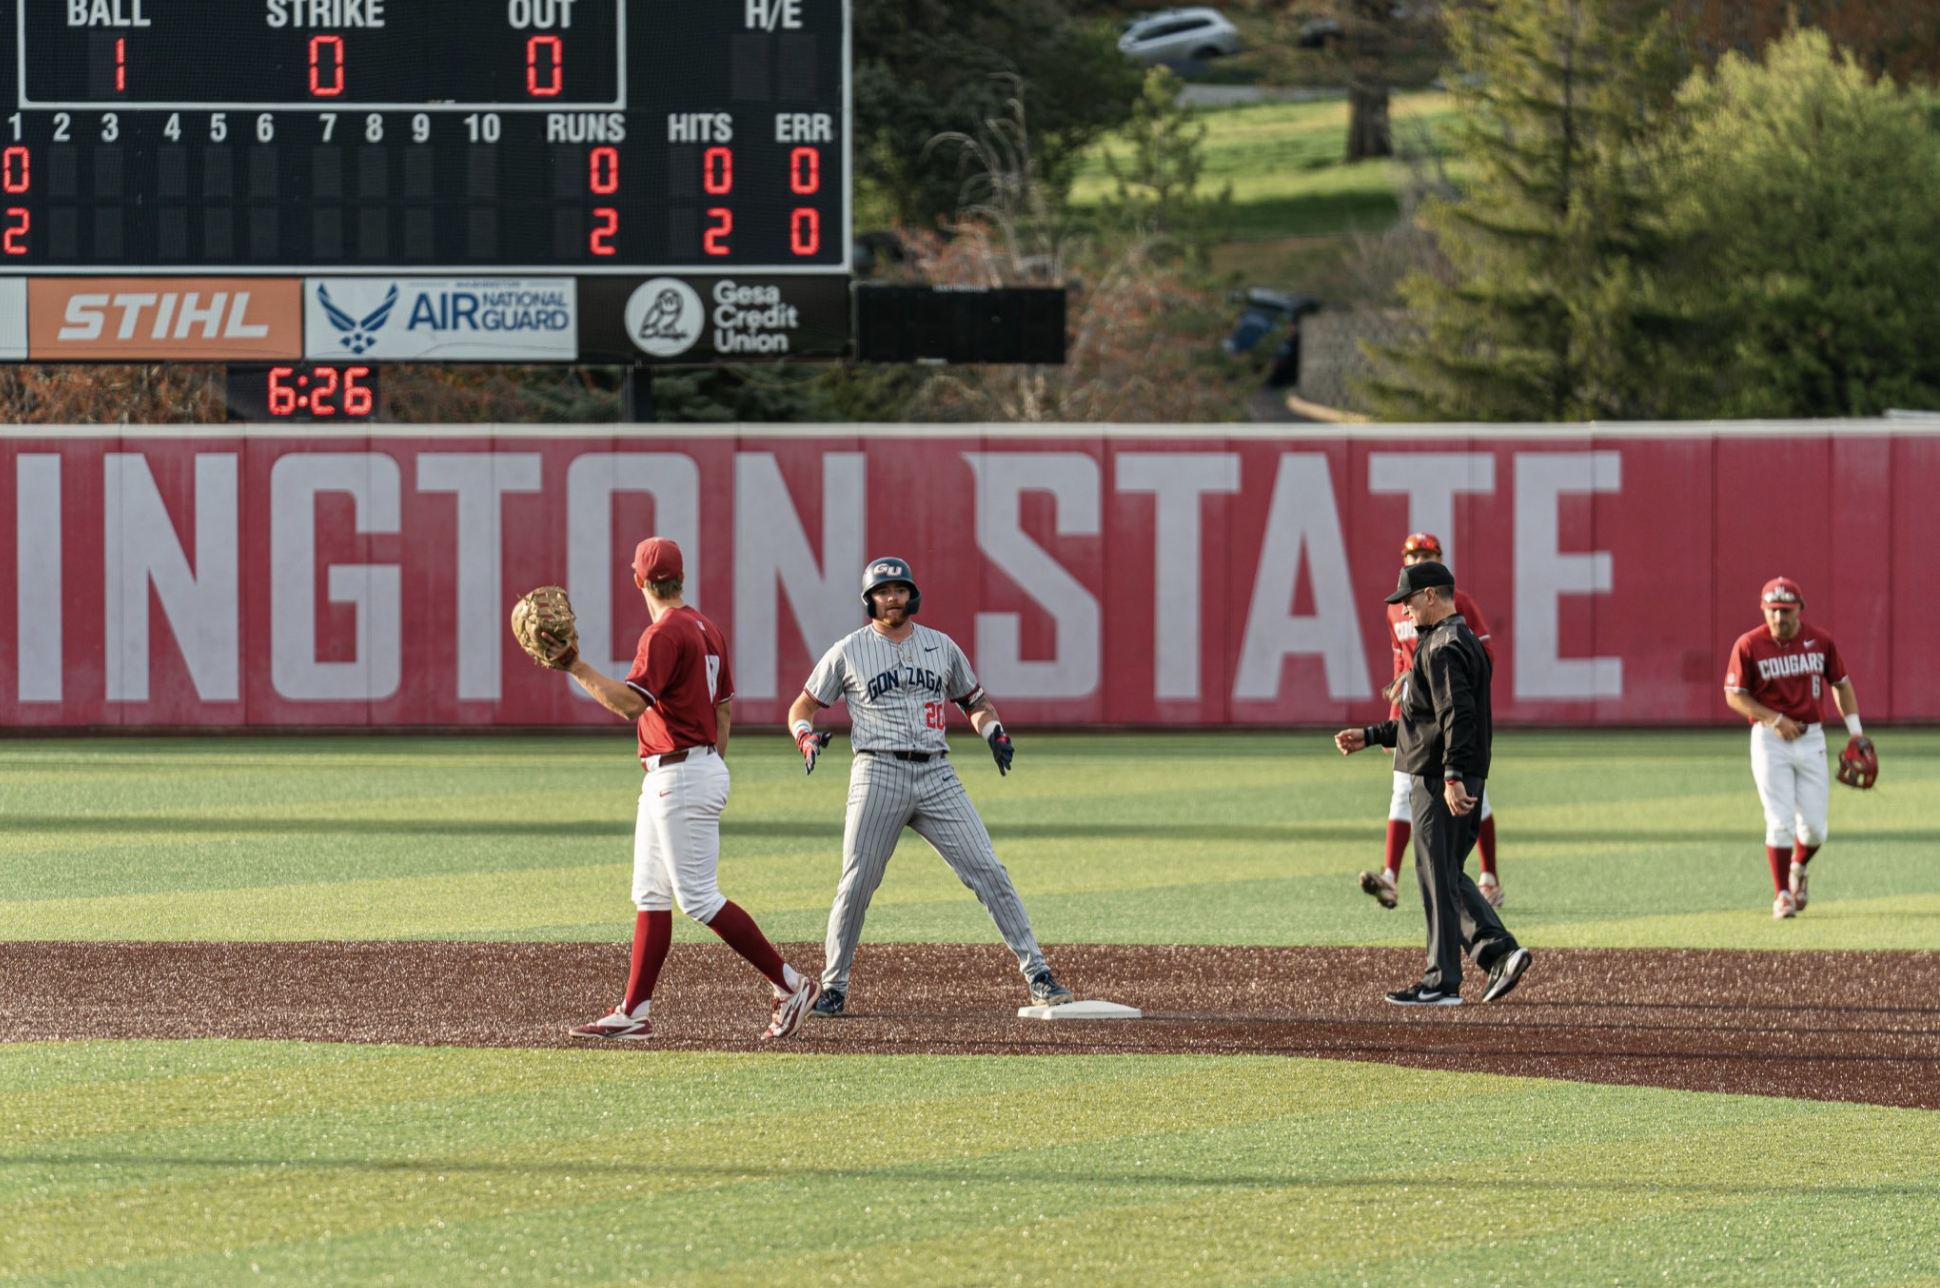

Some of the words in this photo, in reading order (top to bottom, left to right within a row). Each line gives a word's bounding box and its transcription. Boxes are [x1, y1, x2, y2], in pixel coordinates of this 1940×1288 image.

[67, 0, 151, 27] BALL
[266, 0, 386, 28] STRIKE
[508, 0, 576, 29] OUT
[745, 0, 803, 32] H/E
[115, 37, 126, 92] 1
[308, 35, 345, 96] 0
[526, 35, 563, 96] 0
[8, 112, 22, 141] 1
[53, 112, 71, 142] 2
[101, 112, 119, 143] 3
[163, 112, 182, 142] 4
[210, 112, 227, 143] 5
[256, 112, 274, 143] 6
[319, 112, 337, 142] 7
[365, 112, 384, 143] 8
[411, 113, 430, 143] 9
[464, 113, 501, 143] 10
[546, 112, 626, 143] RUNS
[667, 112, 733, 143] HITS
[775, 113, 832, 143] ERR
[2, 146, 31, 194] 0
[589, 146, 619, 195] 0
[703, 146, 733, 195] 0
[790, 146, 820, 195] 0
[2, 206, 31, 255] 2
[589, 207, 619, 256] 2
[703, 207, 733, 256] 2
[790, 207, 820, 256] 0
[482, 291, 568, 309] NATIONAL
[713, 280, 780, 304] Gesa
[57, 291, 269, 341] STIHL
[406, 292, 480, 331] AIR
[481, 309, 570, 331] GUARD
[713, 304, 798, 329] Credit
[714, 328, 788, 352] Union
[267, 366, 373, 416] 6:26
[873, 563, 903, 577] GU
[960, 451, 1622, 701] STATE
[1758, 652, 1825, 681] COUGARS
[867, 666, 943, 701] GONZAGA
[1811, 675, 1821, 699] 6
[924, 702, 945, 731] 20
